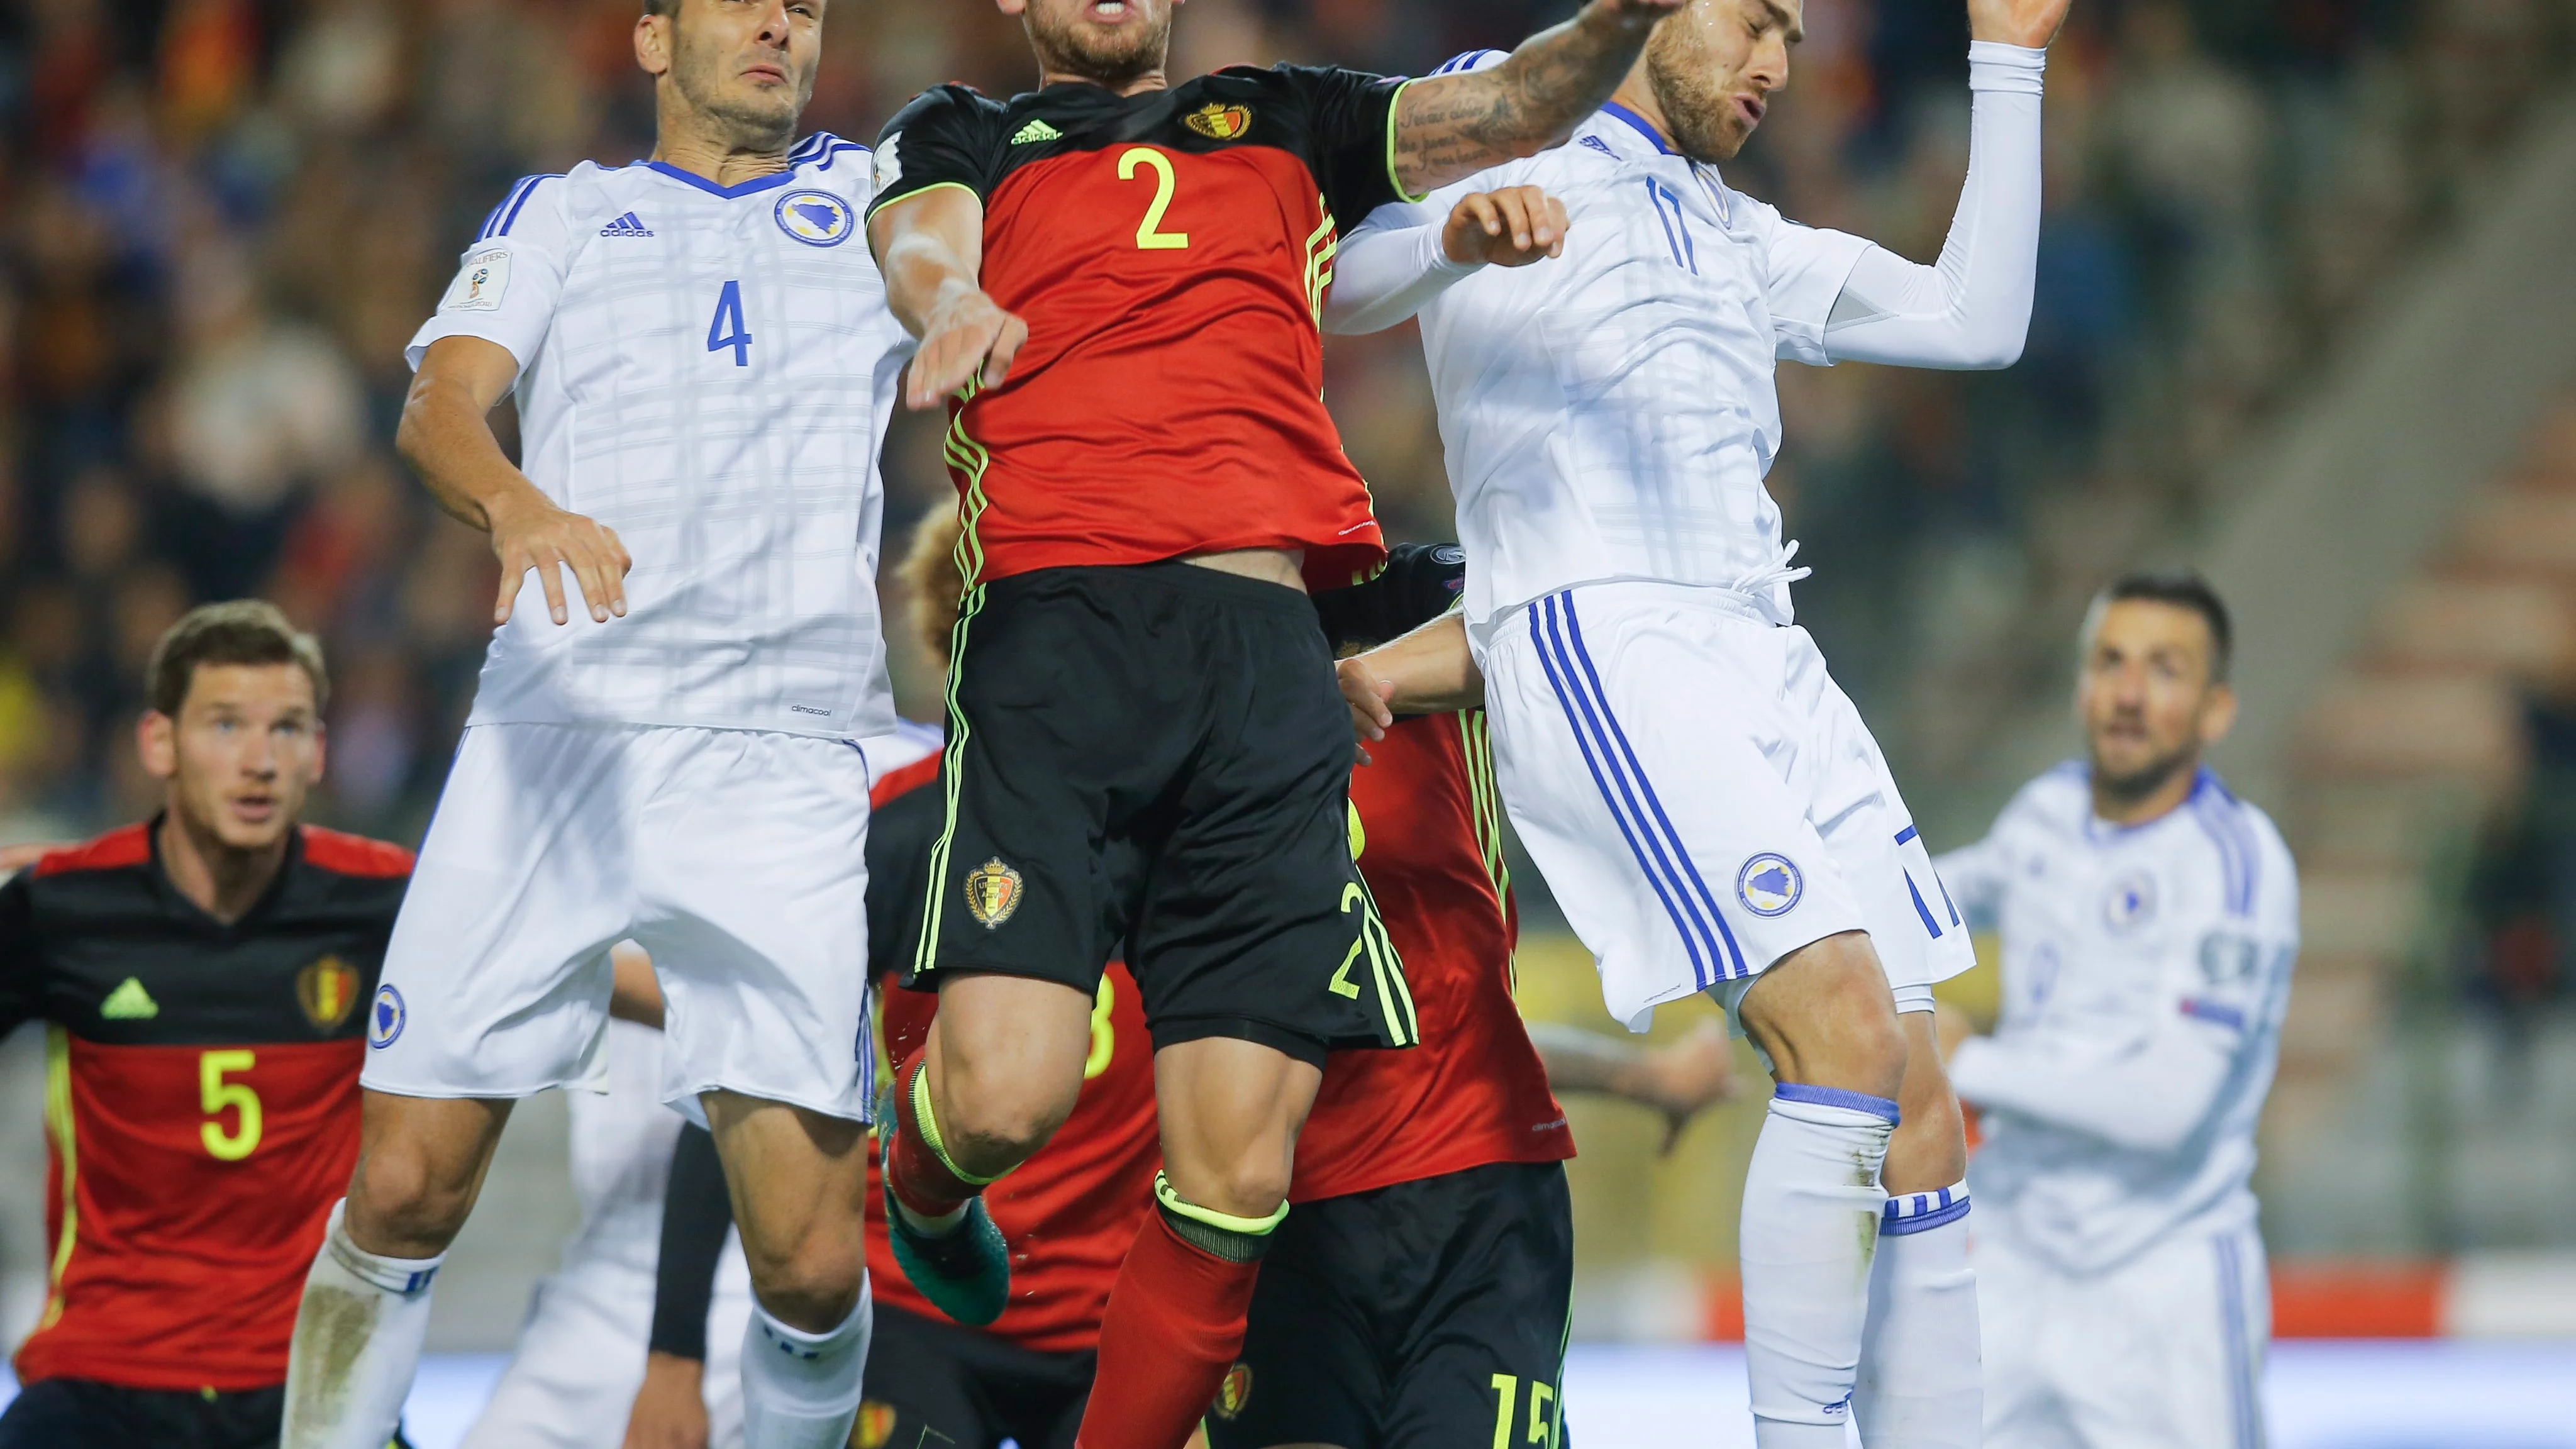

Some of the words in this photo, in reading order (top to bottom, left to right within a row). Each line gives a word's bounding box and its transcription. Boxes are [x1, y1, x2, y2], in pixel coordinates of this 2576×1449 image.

[600, 229, 654, 237] adidas
[1117, 147, 1189, 250] 2
[1646, 175, 1699, 277] 17
[708, 280, 753, 366] 4
[792, 704, 831, 716] climacool
[199, 1049, 263, 1161] 5
[1491, 1373, 1554, 1449] 15
